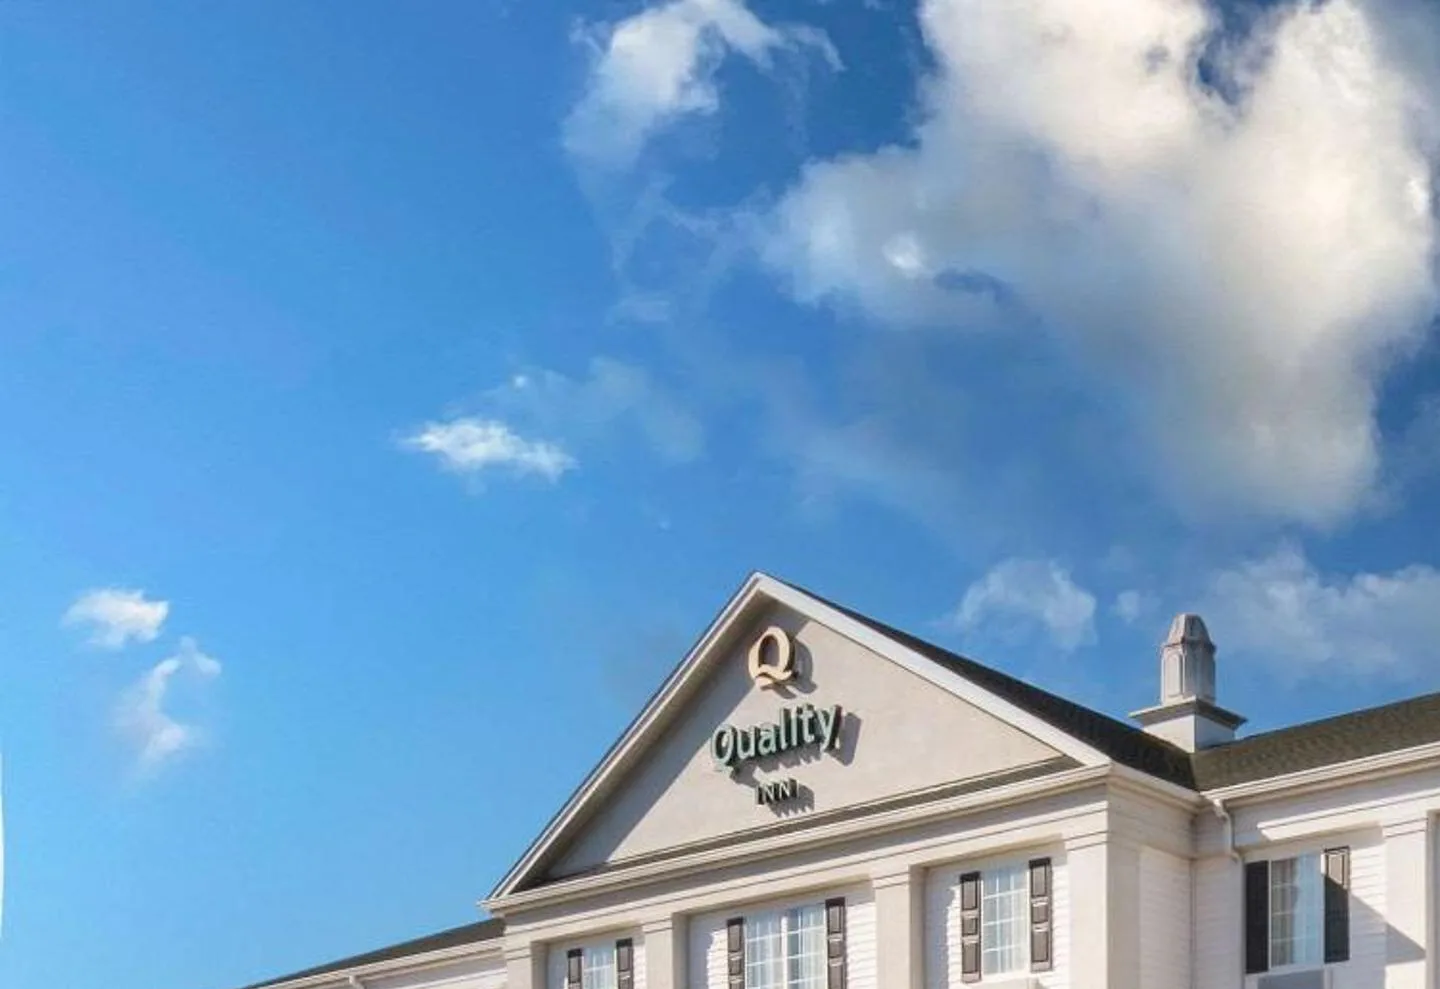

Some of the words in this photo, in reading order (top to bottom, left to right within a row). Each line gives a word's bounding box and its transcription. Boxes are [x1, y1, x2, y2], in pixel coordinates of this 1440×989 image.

[748, 626, 792, 690] Q
[711, 703, 842, 772] Quality
[757, 776, 801, 805] INN
